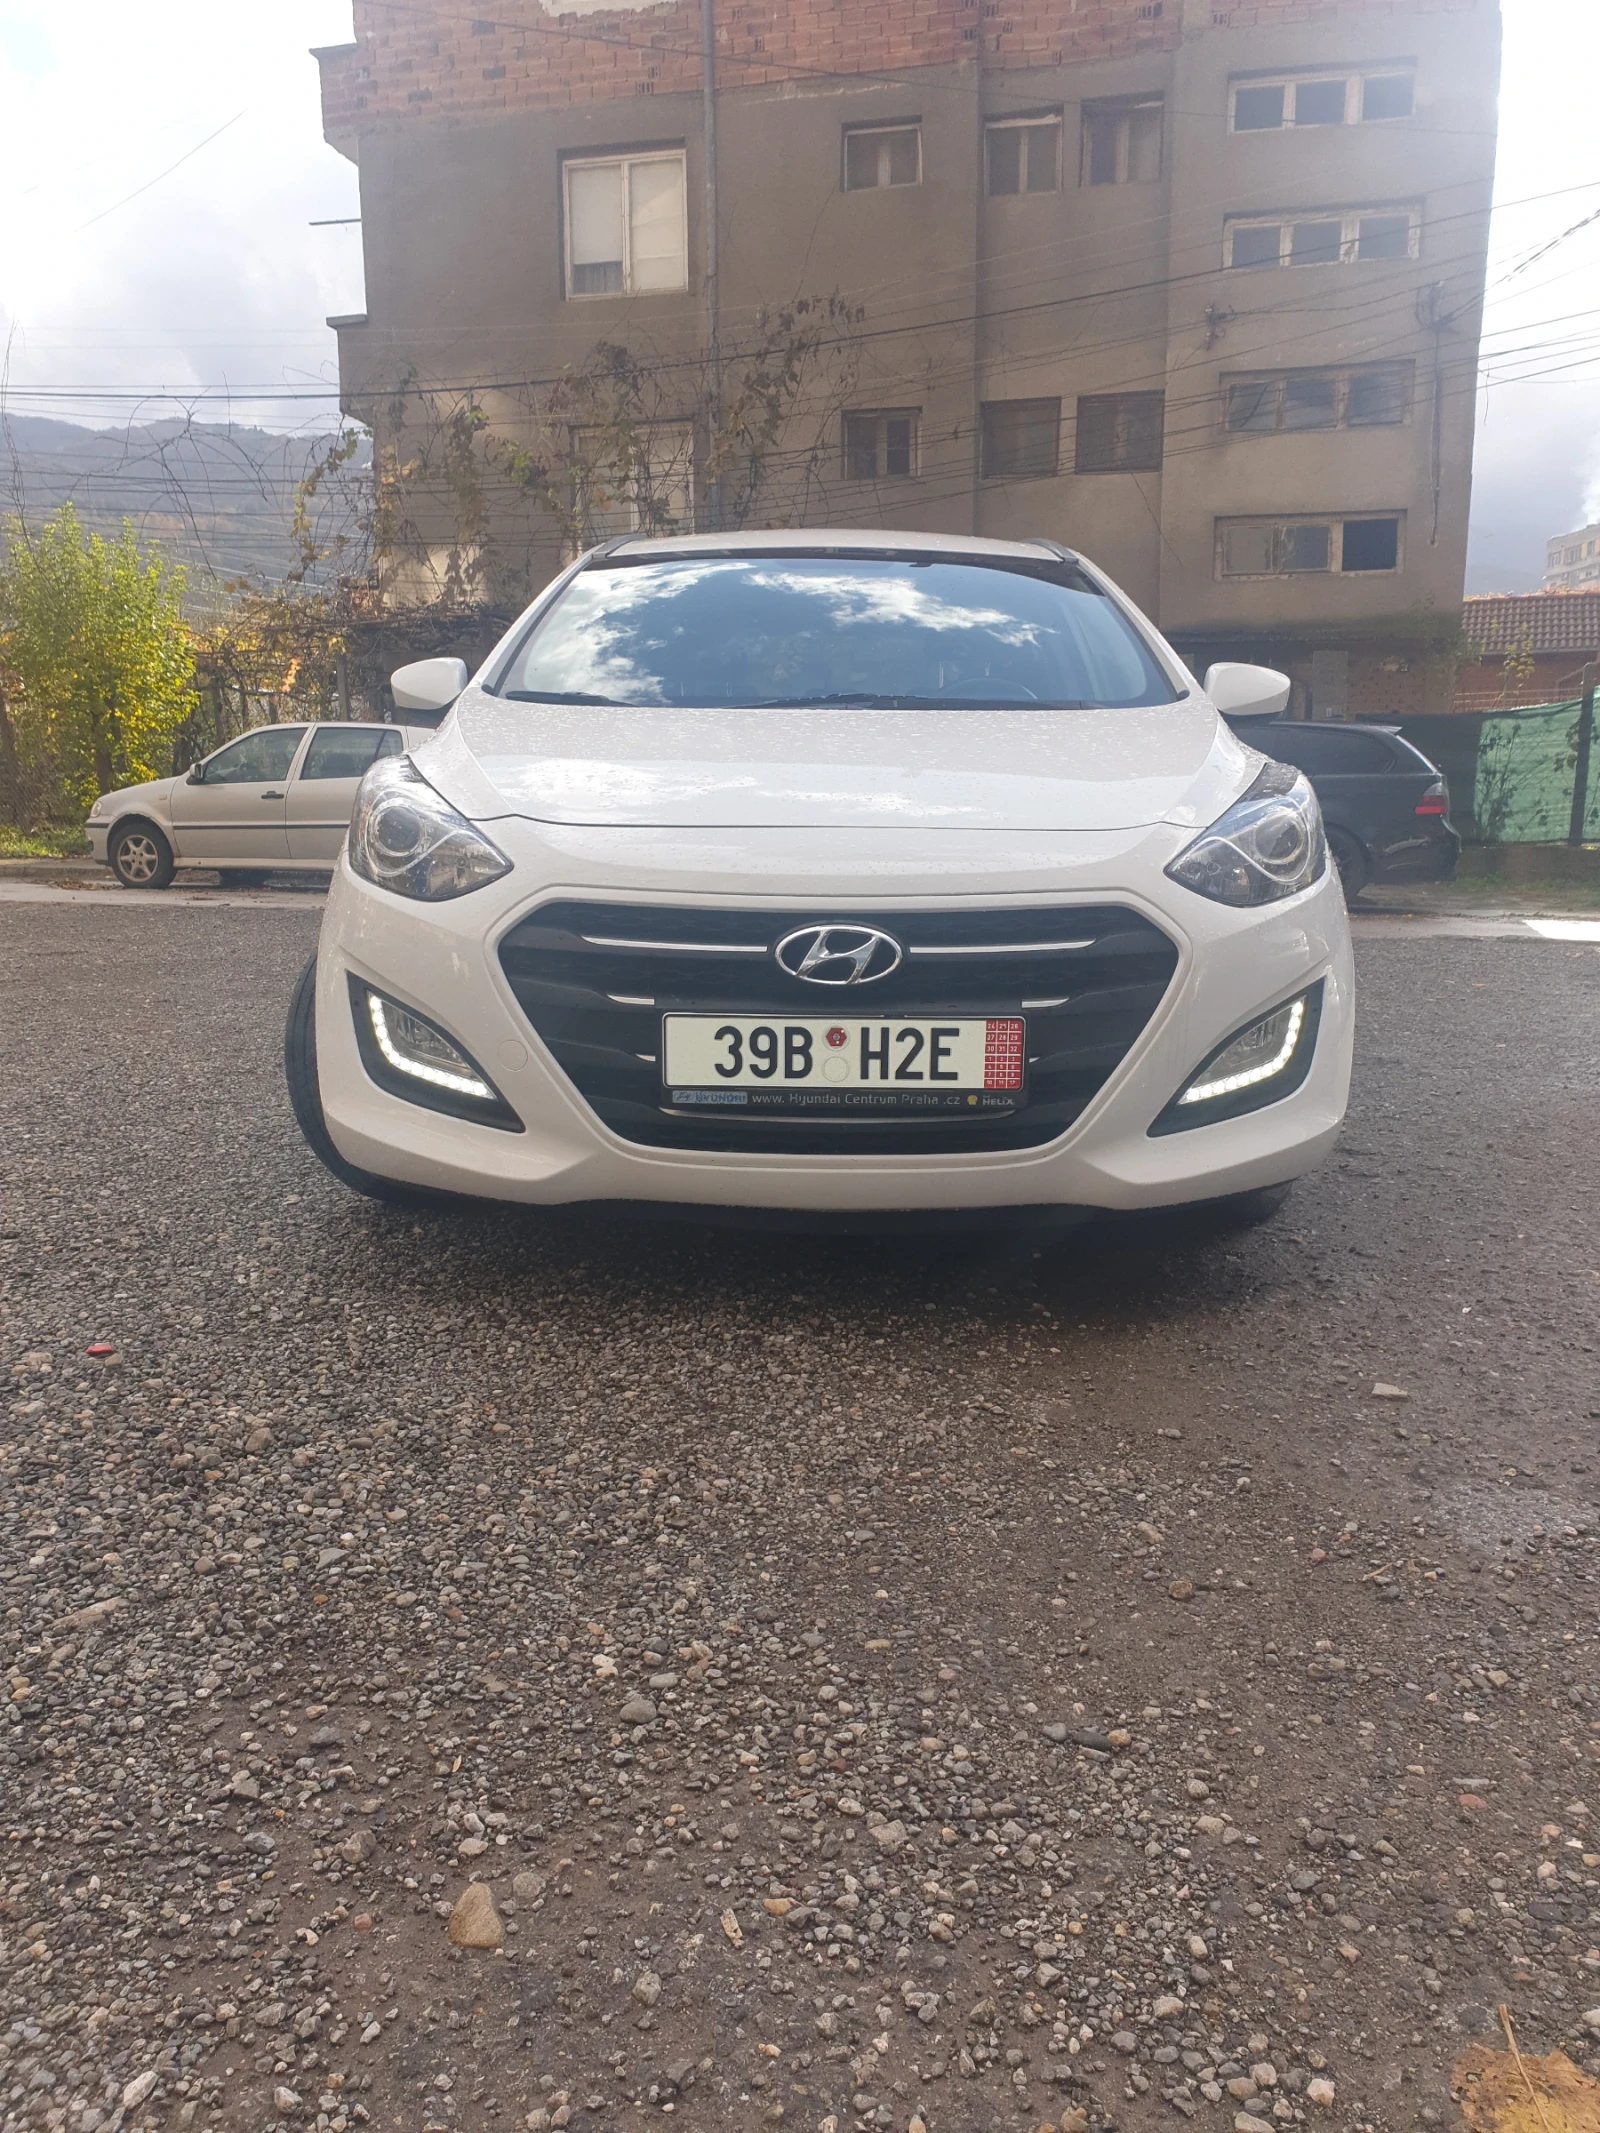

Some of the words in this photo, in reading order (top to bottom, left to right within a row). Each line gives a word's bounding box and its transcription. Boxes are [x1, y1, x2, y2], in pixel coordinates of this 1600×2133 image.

[714, 1026, 812, 1079] 39B
[860, 1026, 960, 1080] H2E
[790, 1093, 841, 1106] Hyundai
[845, 1094, 897, 1105] Centrum
[901, 1094, 939, 1105] Praha
